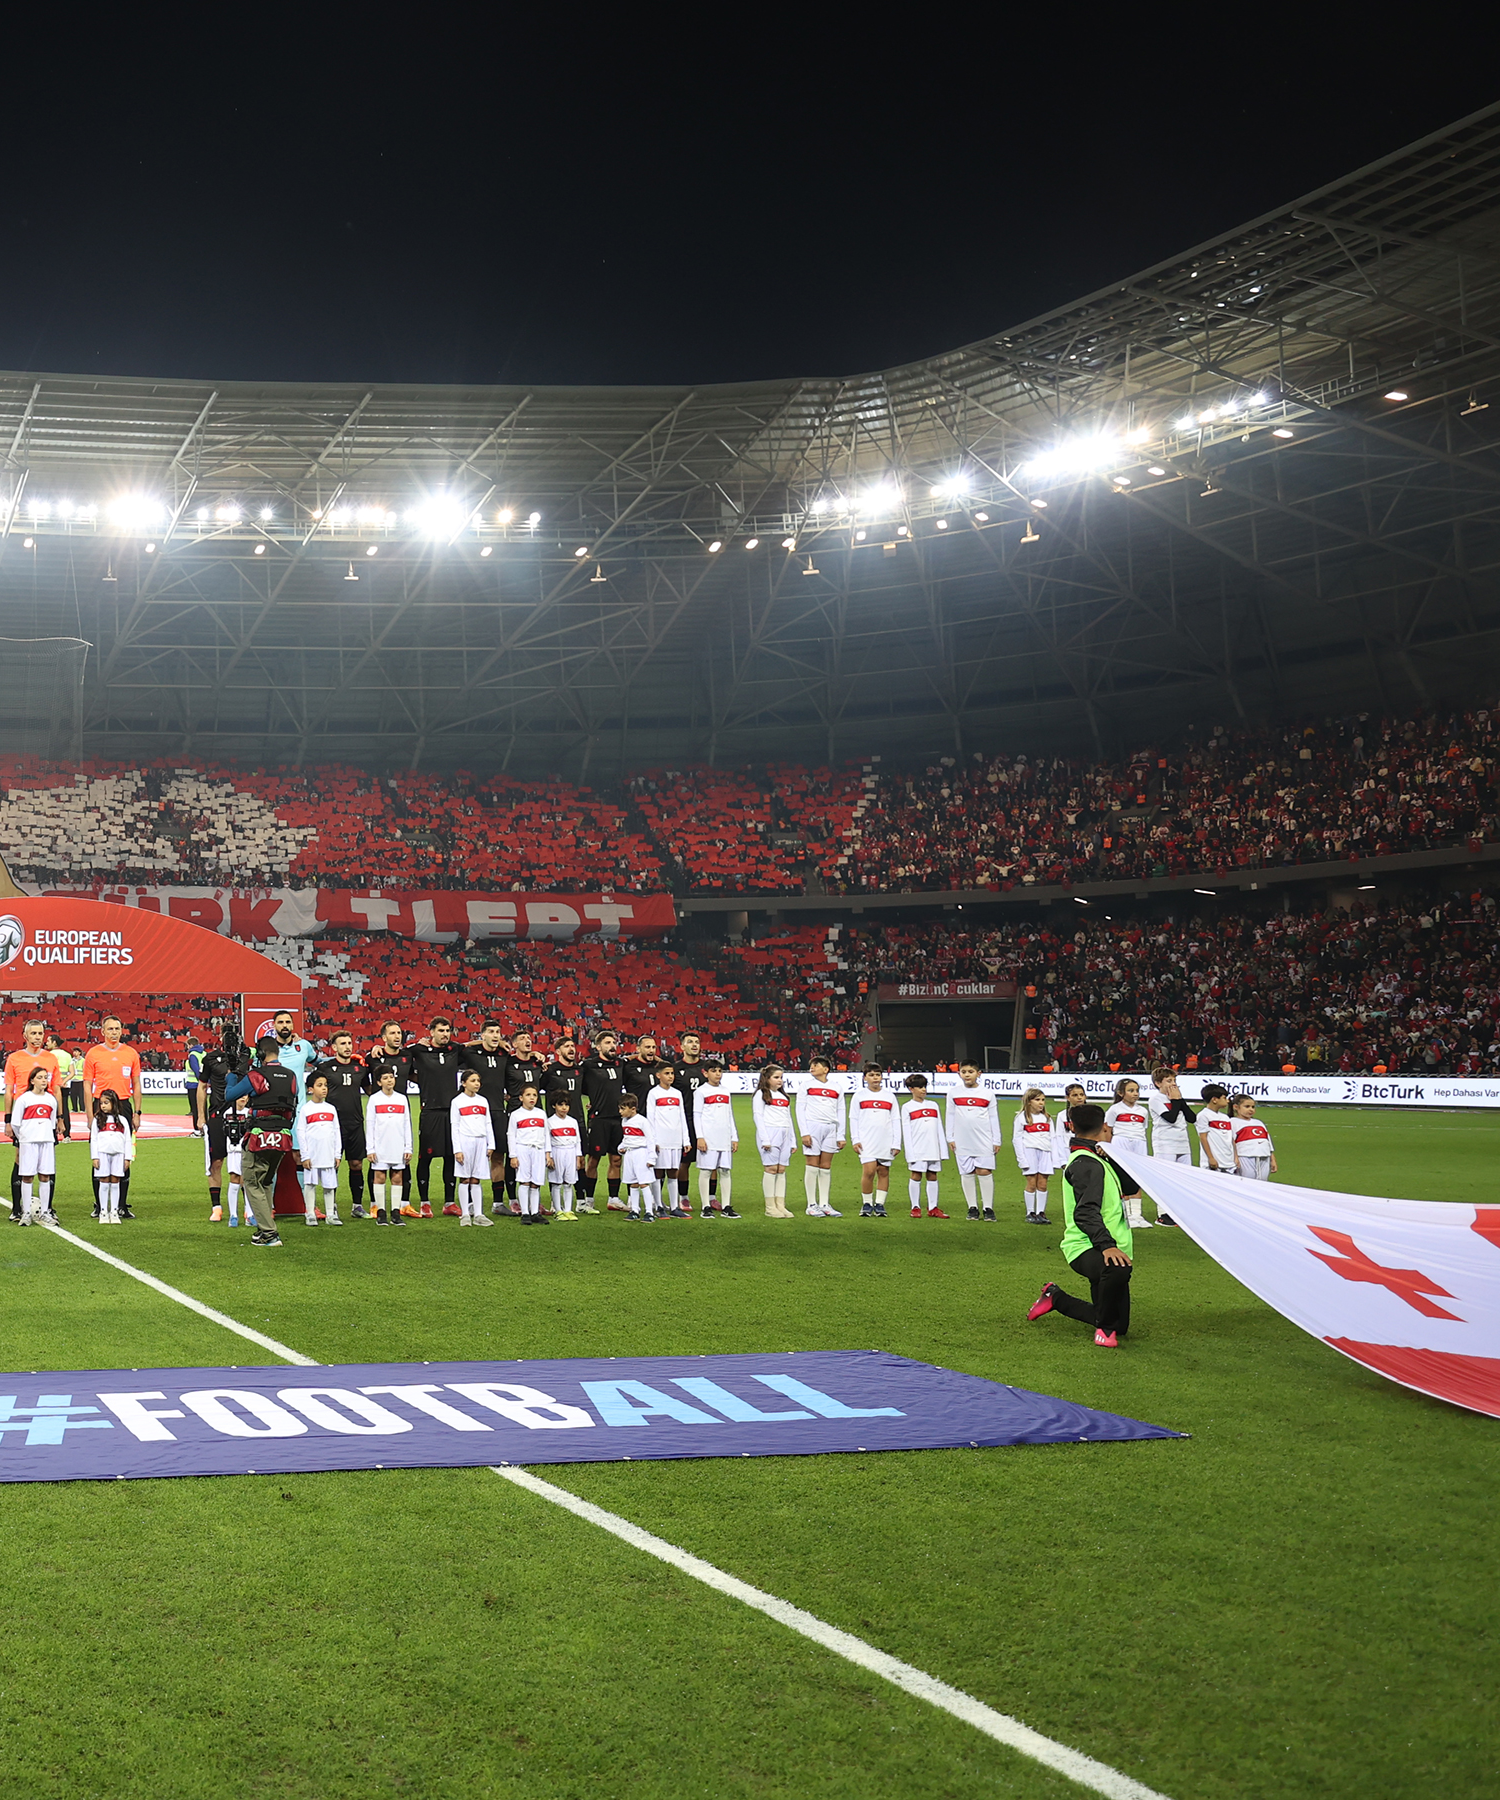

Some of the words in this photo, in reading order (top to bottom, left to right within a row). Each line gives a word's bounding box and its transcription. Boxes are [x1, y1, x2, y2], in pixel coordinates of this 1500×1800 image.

[42, 886, 283, 942] RK
[35, 930, 122, 946] EUROPEAN
[23, 946, 134, 966] QUALIFIERS
[342, 1073, 352, 1086] 15
[690, 1078, 700, 1090] 22
[984, 1079, 1022, 1091] BtcTurk
[1277, 1085, 1291, 1094] Hep
[1362, 1084, 1425, 1099] BtcTurk
[1434, 1088, 1451, 1097] Hep
[1452, 1088, 1483, 1097] Dahası
[1485, 1089, 1500, 1097] Var
[258, 1132, 282, 1148] 142
